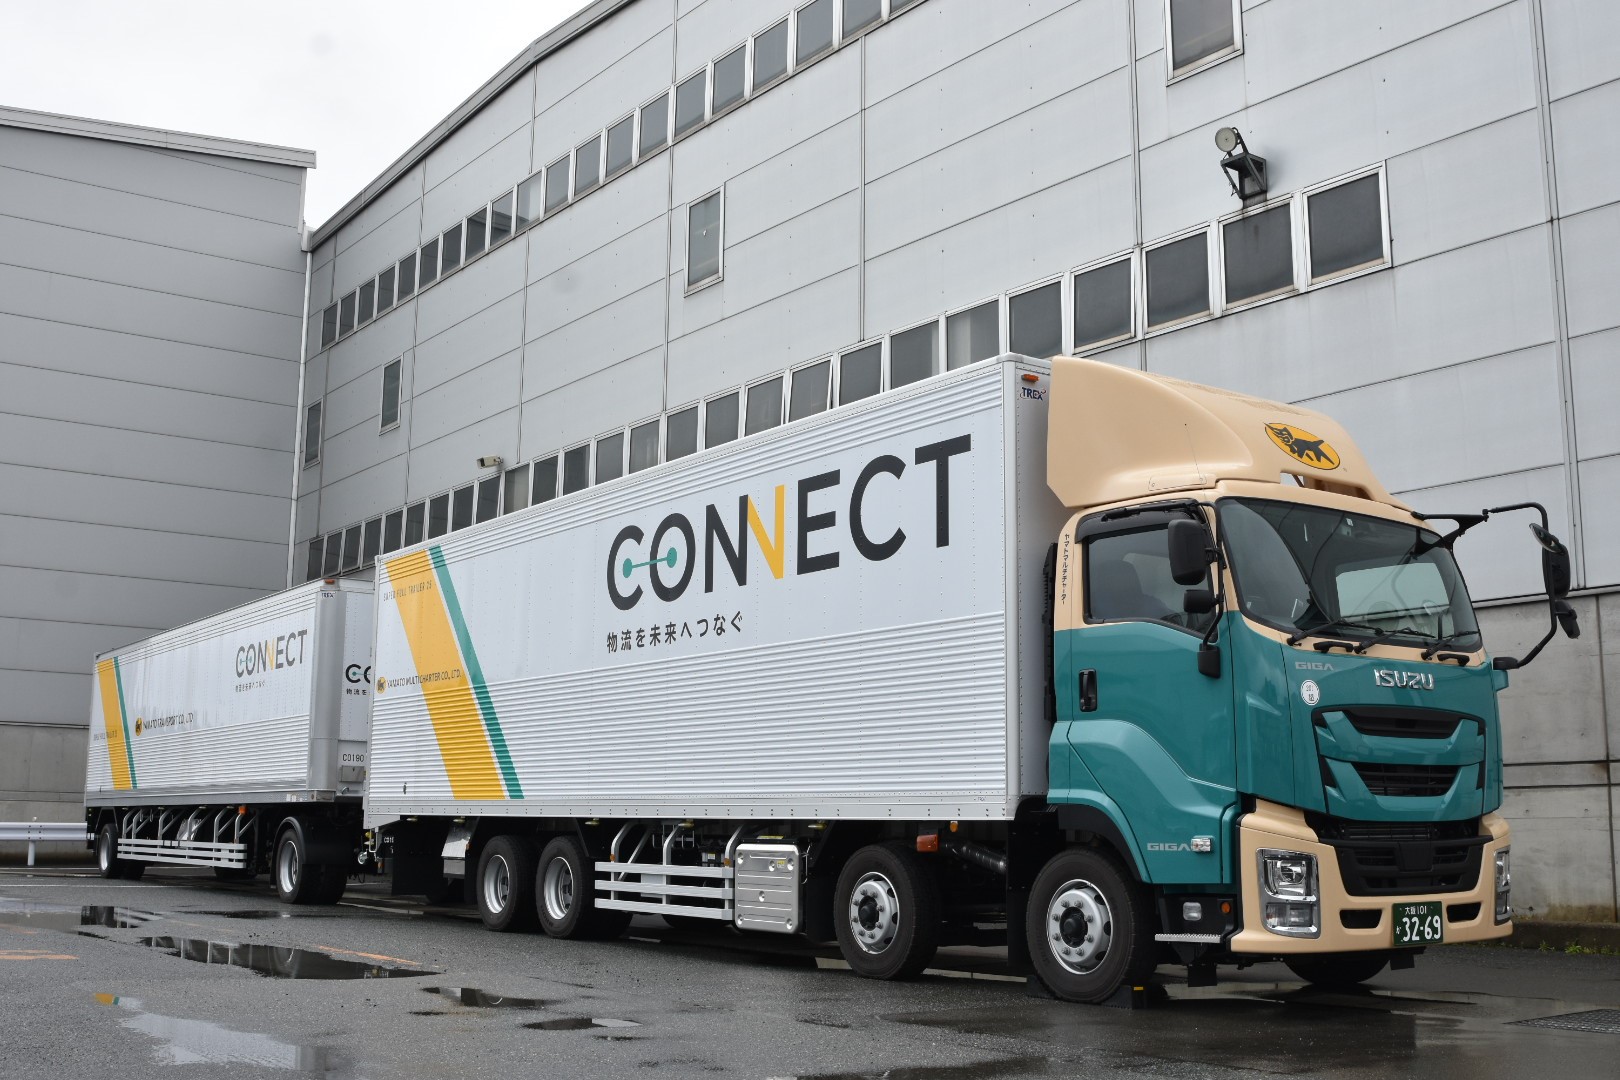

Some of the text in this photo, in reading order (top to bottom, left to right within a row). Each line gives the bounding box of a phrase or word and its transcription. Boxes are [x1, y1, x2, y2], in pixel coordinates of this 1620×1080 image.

[1021, 386, 1045, 401] TREX
[606, 433, 972, 611] CONNECT
[606, 610, 742, 653] 物流を未来へつなぐ
[235, 629, 308, 678] CONNECT
[1294, 661, 1334, 671] GIGA
[1373, 668, 1434, 690] ISUZU
[1146, 842, 1191, 851] GIGA
[1402, 915, 1441, 942] 32-69
